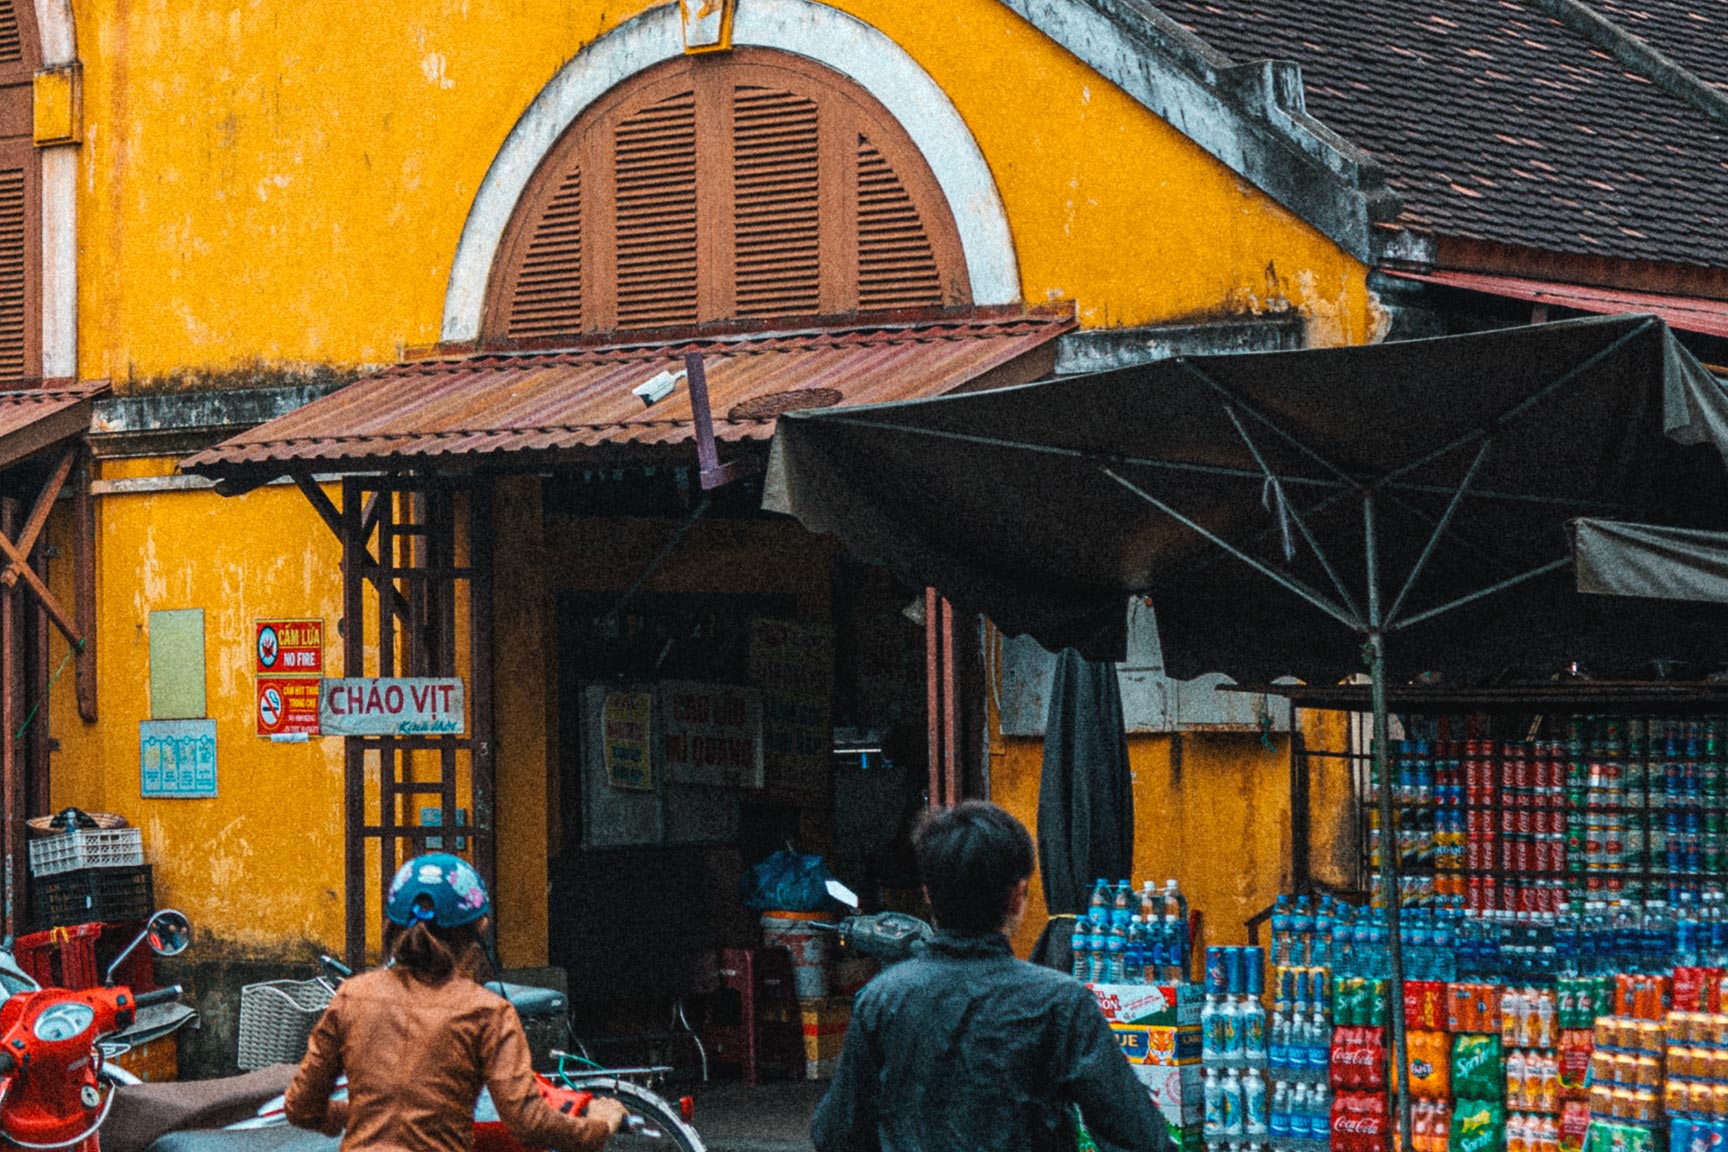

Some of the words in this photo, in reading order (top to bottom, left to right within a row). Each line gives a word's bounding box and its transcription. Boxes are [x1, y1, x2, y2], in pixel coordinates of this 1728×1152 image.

[278, 623, 300, 646] CẤM
[301, 623, 321, 645] LỬA
[283, 652, 295, 666] NO
[296, 652, 316, 666] FIRE
[328, 678, 404, 715] CHÁO
[410, 684, 455, 720] VỊT
